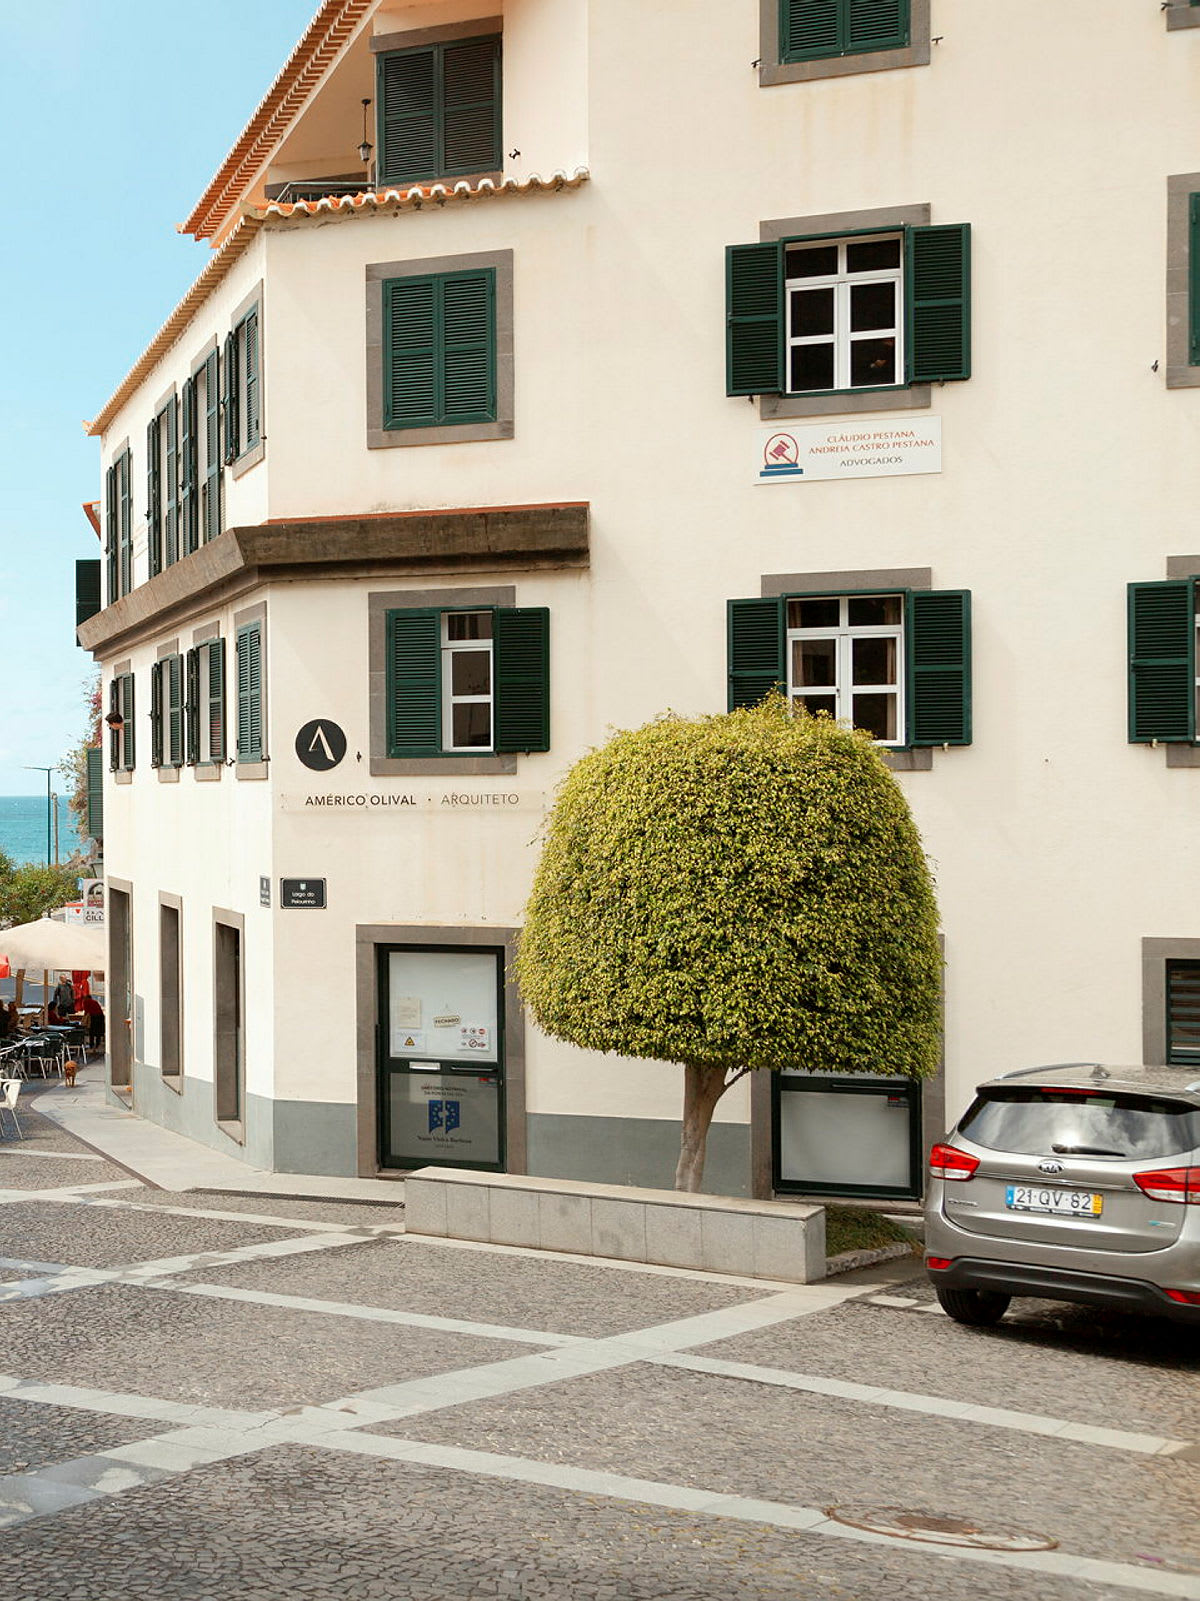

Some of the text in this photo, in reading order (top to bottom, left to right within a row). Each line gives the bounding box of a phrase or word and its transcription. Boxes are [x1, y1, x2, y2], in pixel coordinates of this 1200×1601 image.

[873, 430, 915, 440] PESTANA
[852, 442, 890, 452] CASTRO
[892, 439, 934, 449] PESTANA
[840, 456, 903, 467] ADVOGADOS
[305, 793, 520, 806] AMÉRICO OLIVAL ARQUITETO
